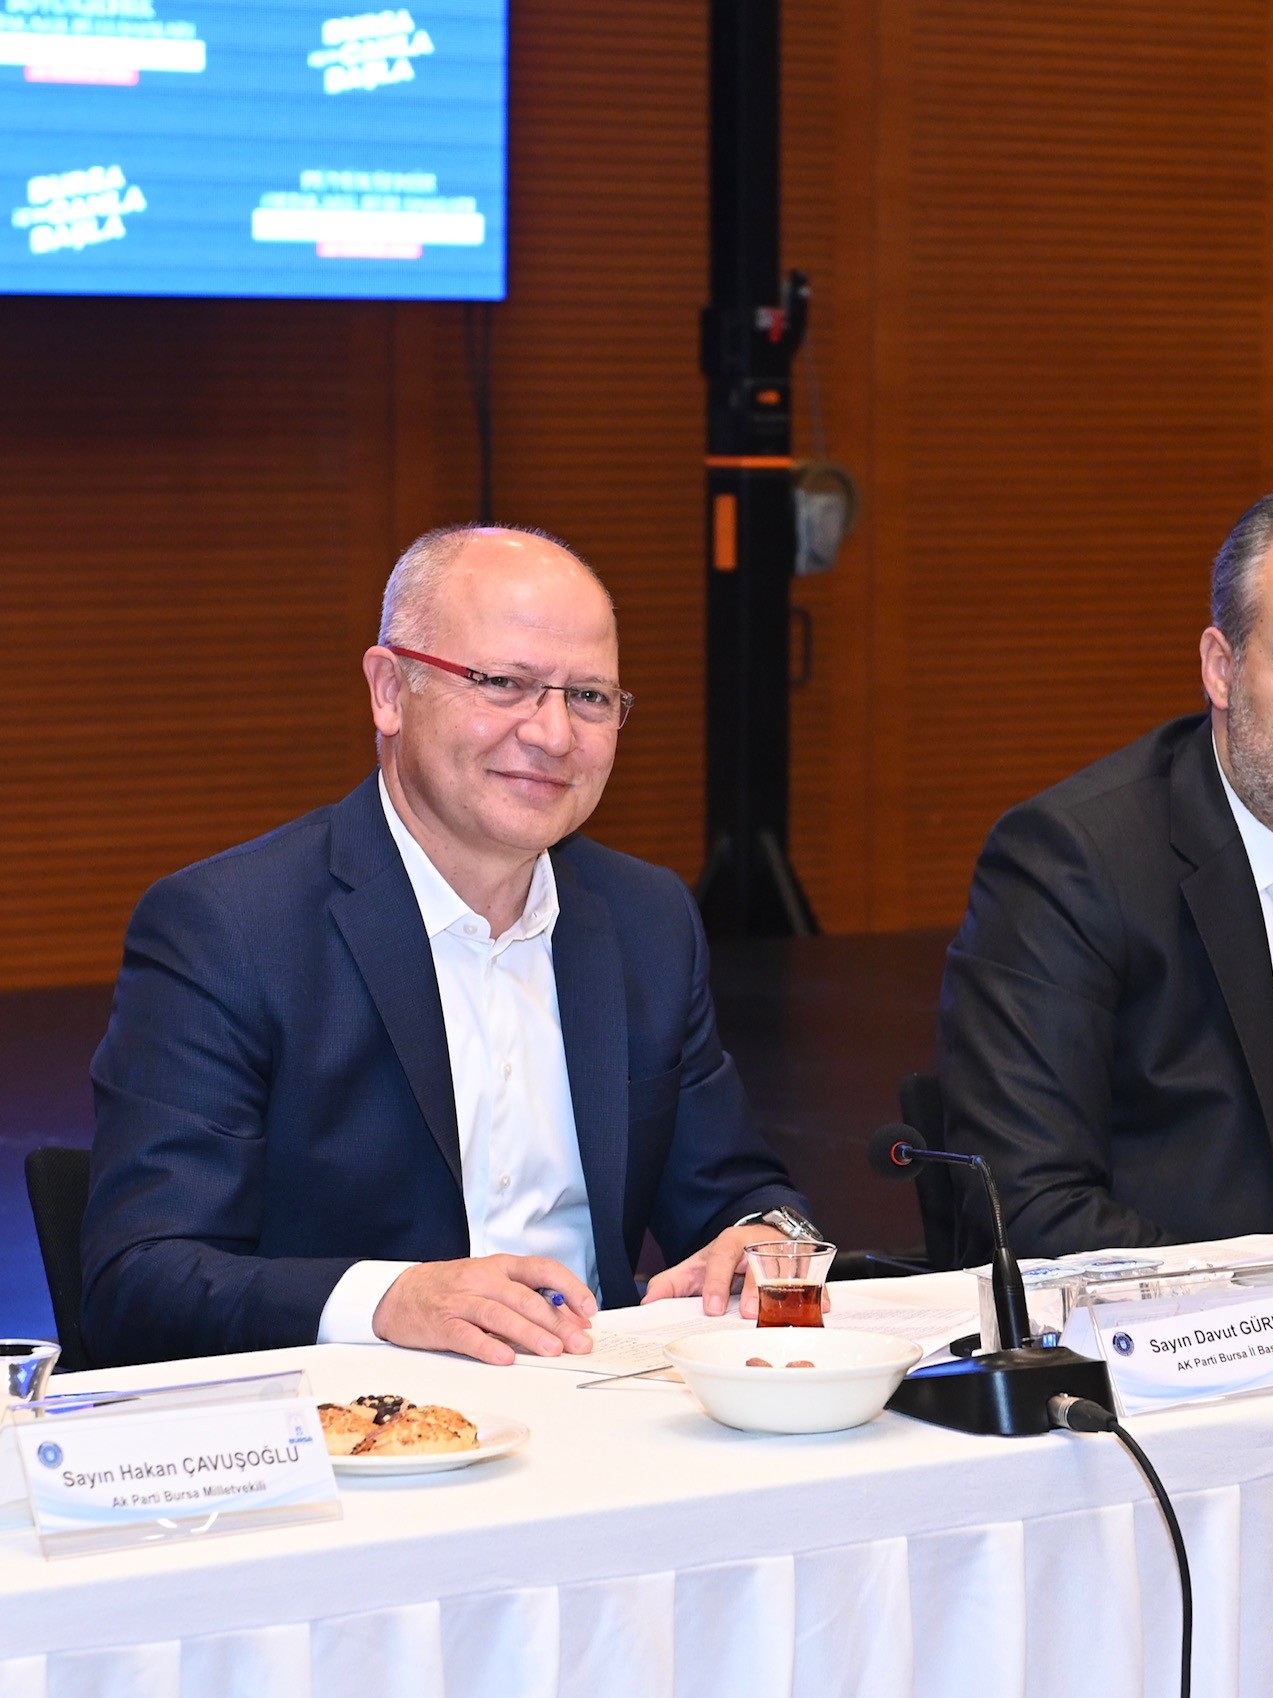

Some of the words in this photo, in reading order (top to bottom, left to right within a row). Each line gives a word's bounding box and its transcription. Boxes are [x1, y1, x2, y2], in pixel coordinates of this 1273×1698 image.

[1150, 1335, 1192, 1353] Sayın
[1194, 1324, 1238, 1344] Davut
[1178, 1359, 1193, 1371] AK
[1194, 1356, 1218, 1367] Parti
[1219, 1350, 1248, 1362] Bursa
[1248, 1345, 1256, 1358] İl
[63, 1470, 115, 1489] Sayın
[120, 1462, 178, 1480] Hakan
[183, 1445, 299, 1477] ÇAVUŞOĞLU
[113, 1496, 127, 1508] Ak
[132, 1493, 161, 1505] Parti
[164, 1489, 200, 1502] Bursa
[203, 1480, 267, 1496] Milletvekili
